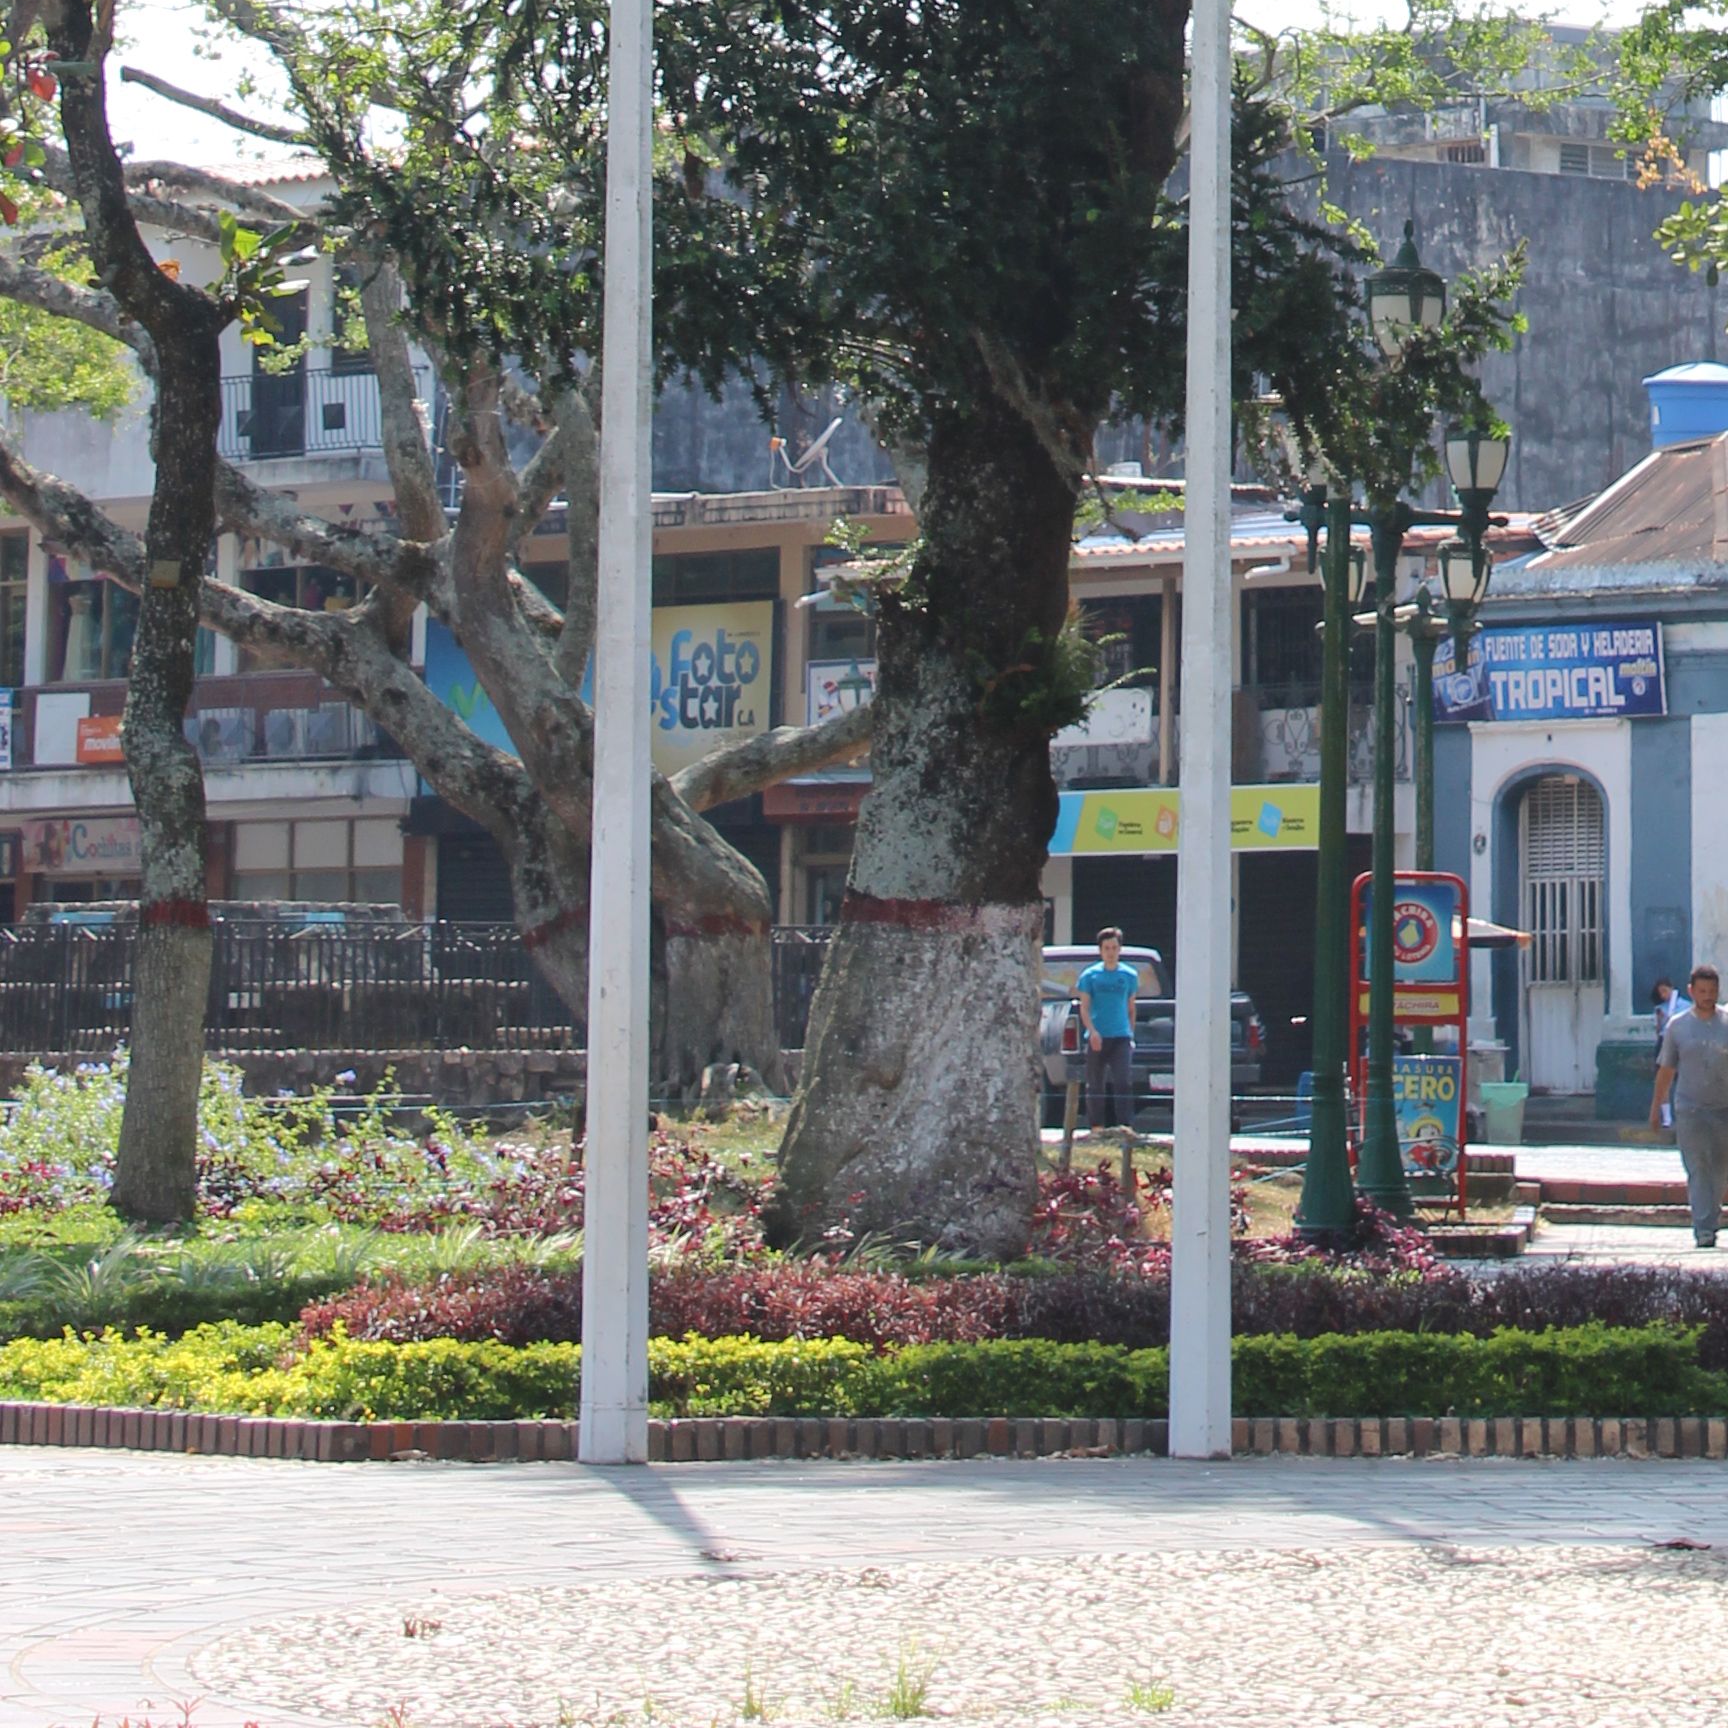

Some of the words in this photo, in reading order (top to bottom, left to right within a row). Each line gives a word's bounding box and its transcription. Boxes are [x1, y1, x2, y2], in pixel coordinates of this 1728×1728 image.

[1485, 635, 1525, 662] FUENTE
[1530, 633, 1544, 659] DE
[1548, 632, 1577, 659] SODA
[1581, 632, 1590, 657] Y
[1593, 628, 1654, 657] HELADERIA
[1489, 666, 1626, 710] TROPICAL
